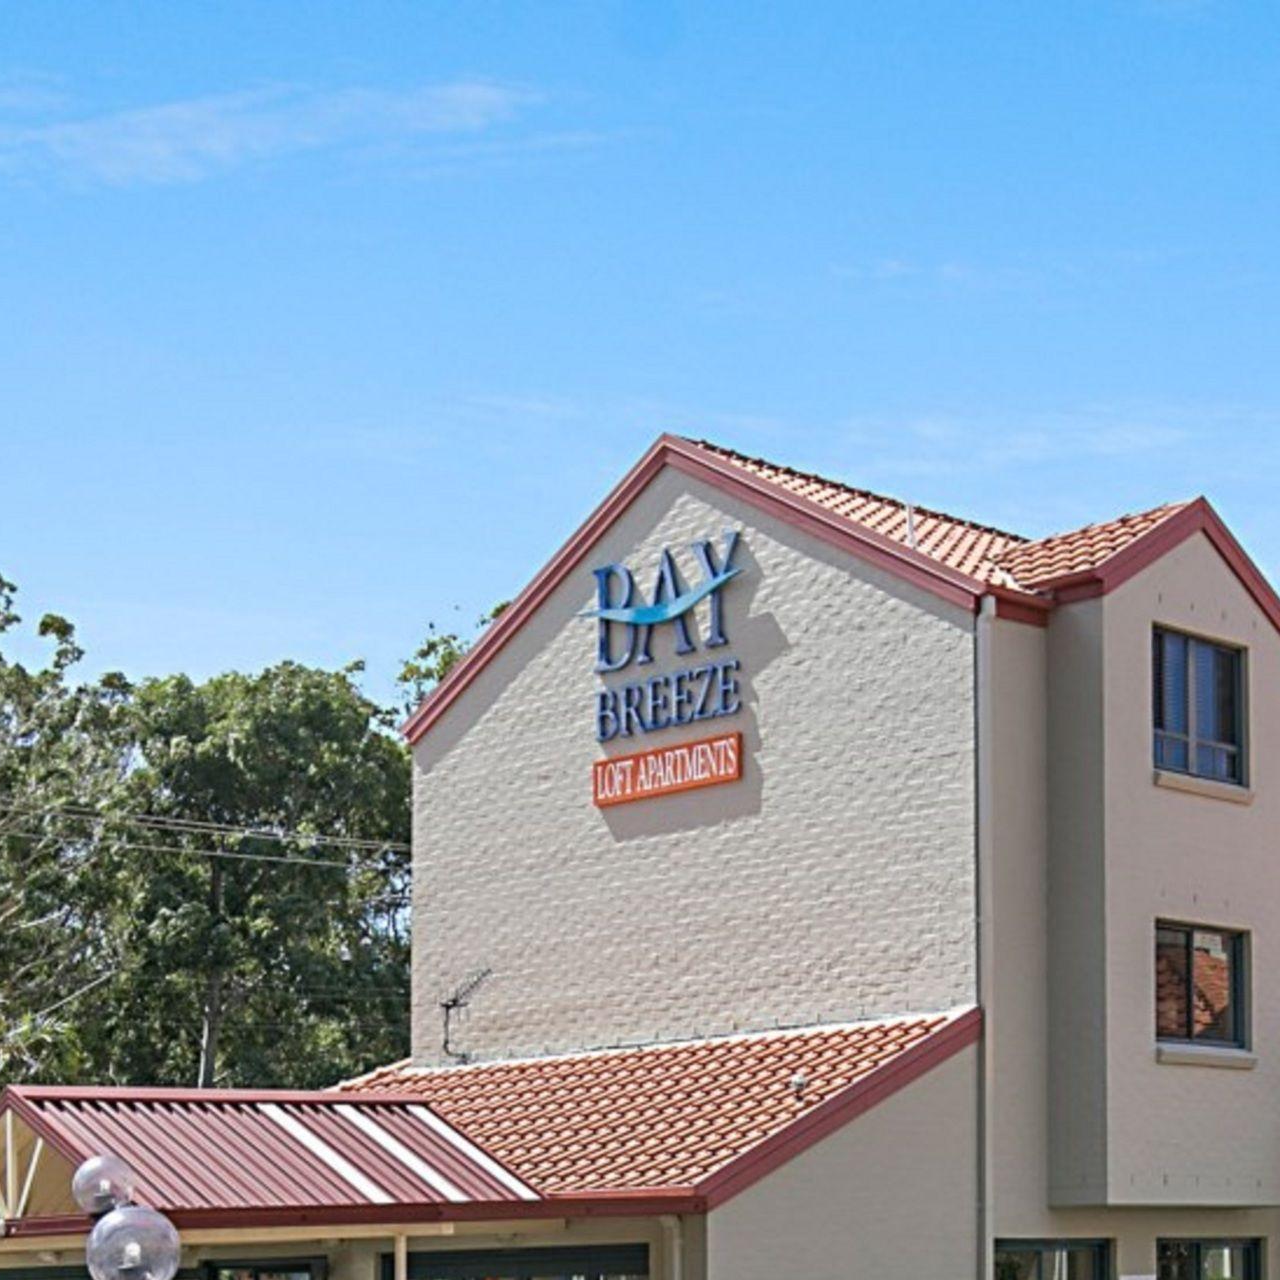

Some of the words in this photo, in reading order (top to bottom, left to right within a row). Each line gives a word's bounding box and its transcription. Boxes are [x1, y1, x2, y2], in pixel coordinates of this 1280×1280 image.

[593, 530, 740, 675] BAY
[594, 660, 743, 744] BREEZE
[596, 760, 635, 800] LOFT
[637, 736, 738, 792] APARTMENTS
